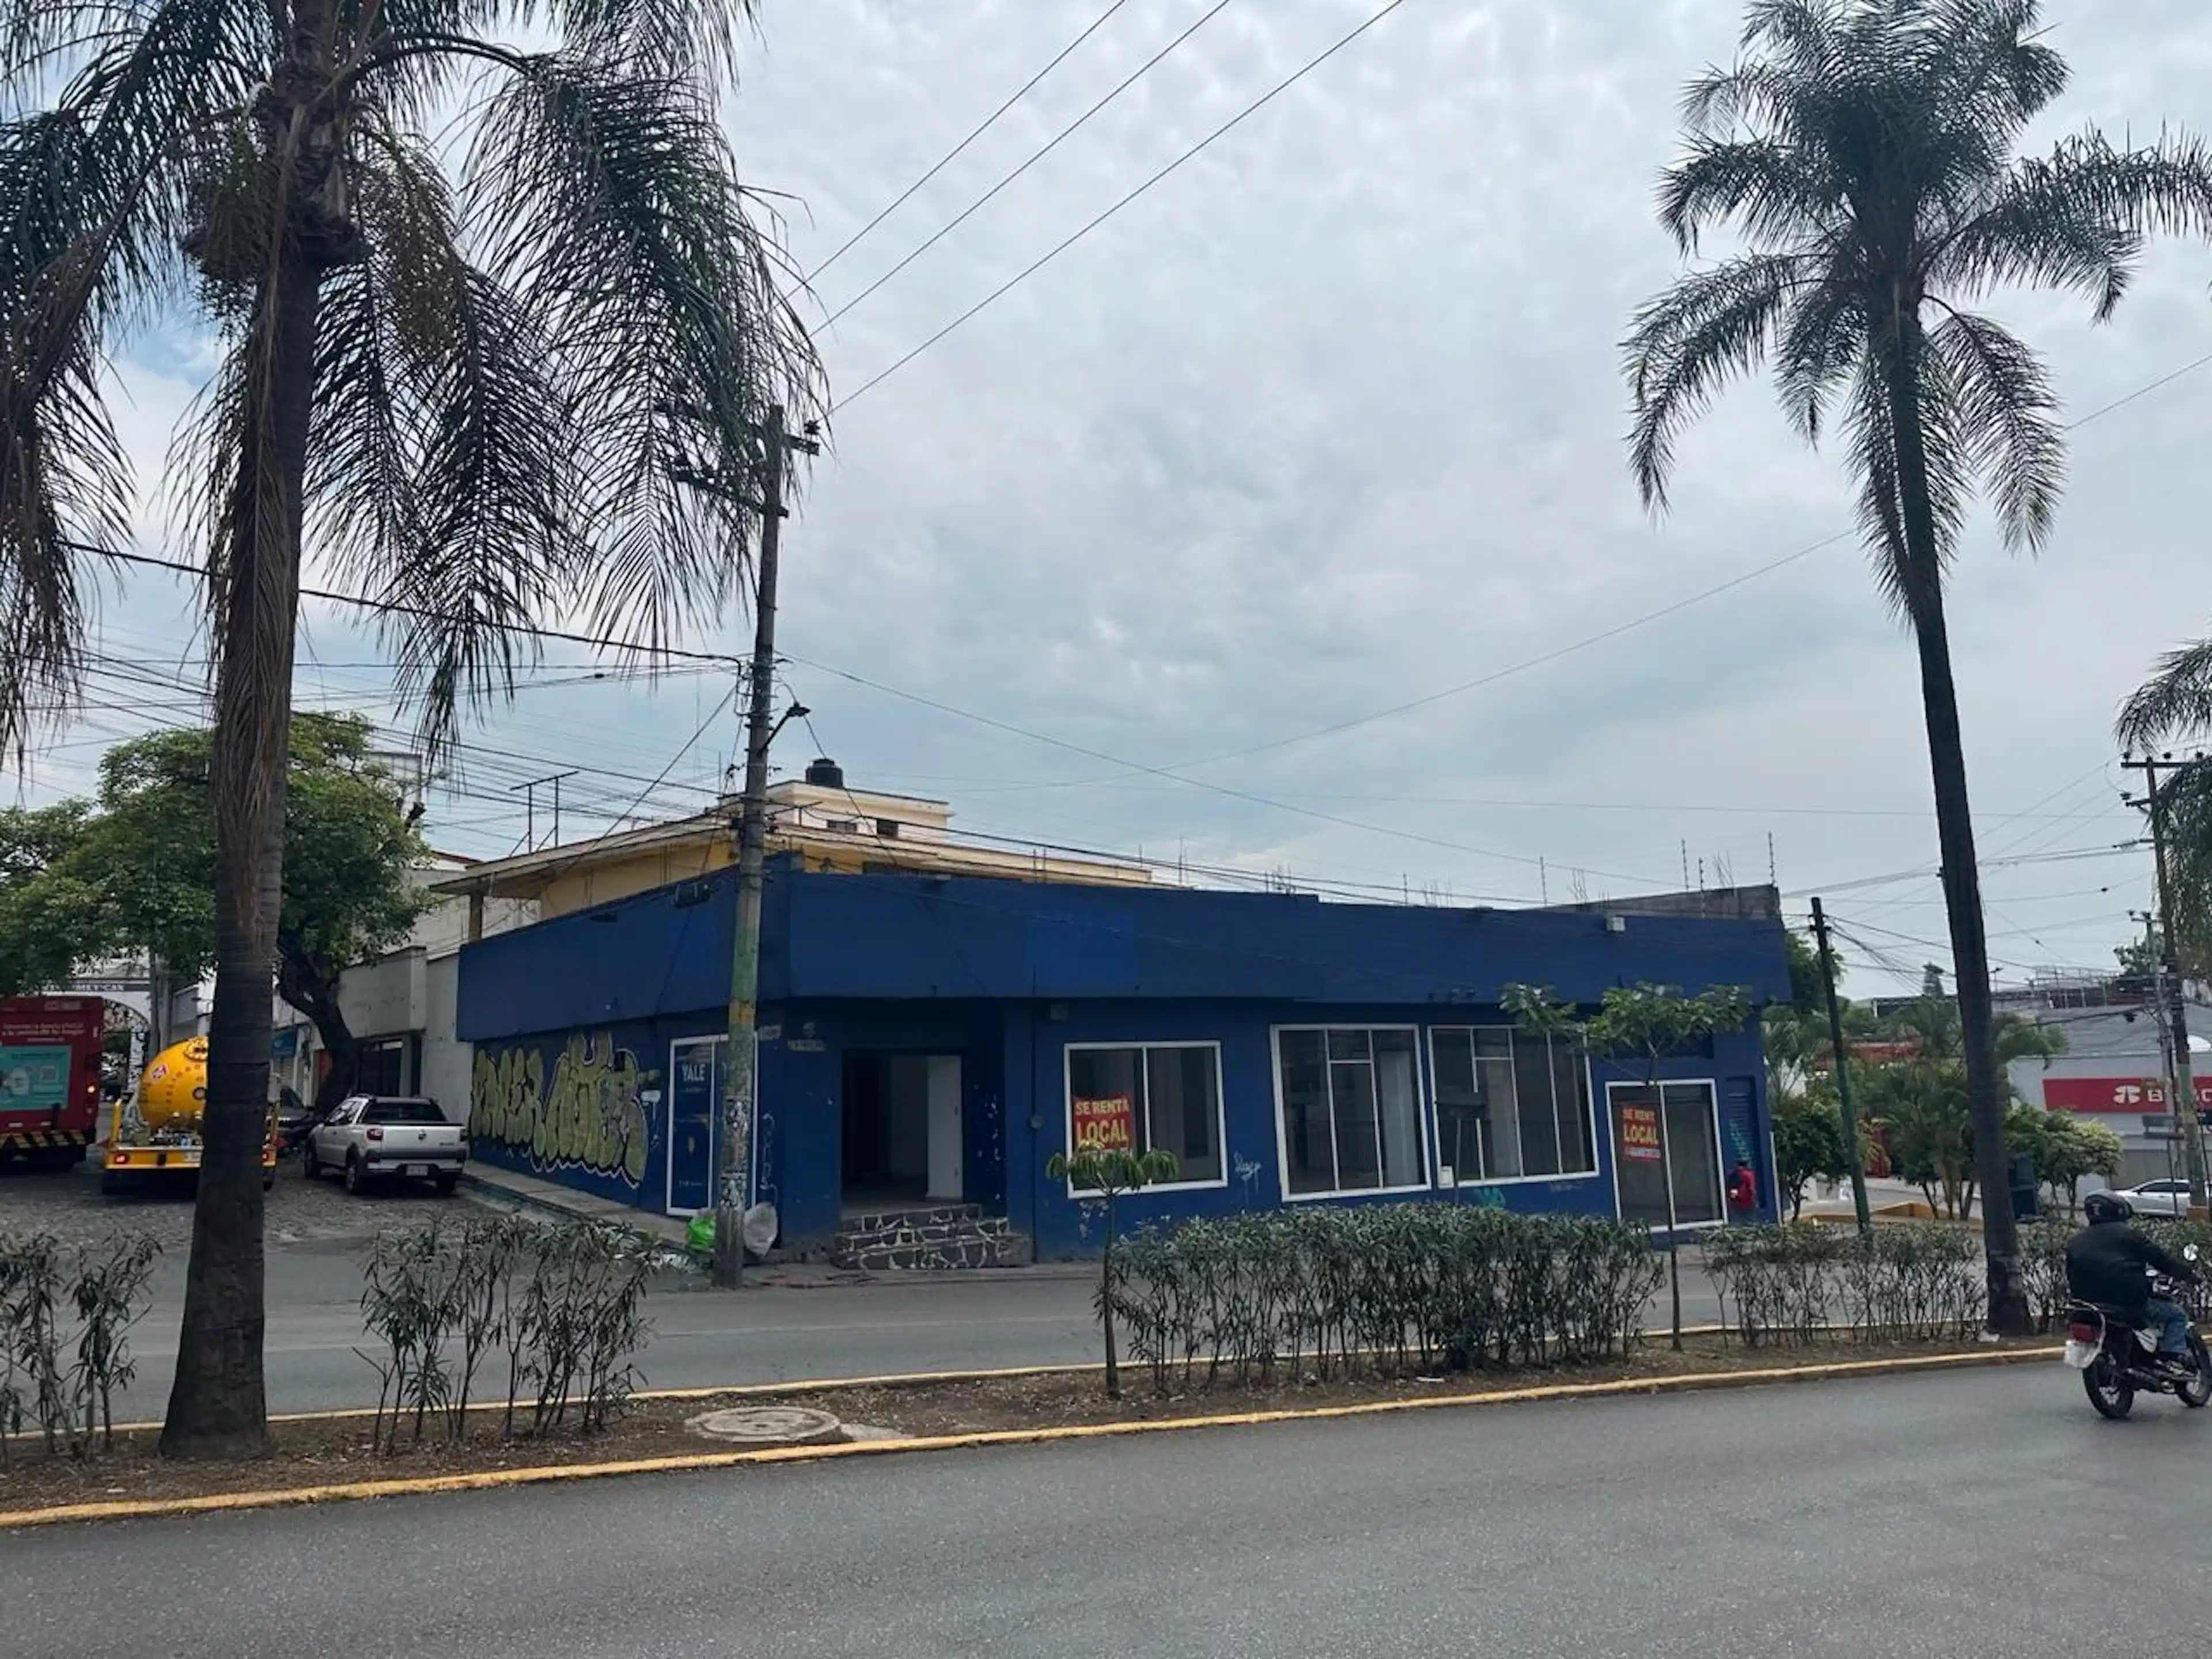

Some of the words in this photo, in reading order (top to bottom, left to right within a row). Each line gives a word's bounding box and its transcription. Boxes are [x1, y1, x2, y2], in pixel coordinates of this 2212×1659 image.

[1075, 1101, 1090, 1115] SE
[1092, 1099, 1129, 1114] RENTA
[1076, 1119, 1128, 1145] LOCAL
[1623, 1123, 1659, 1144] LOCAL
